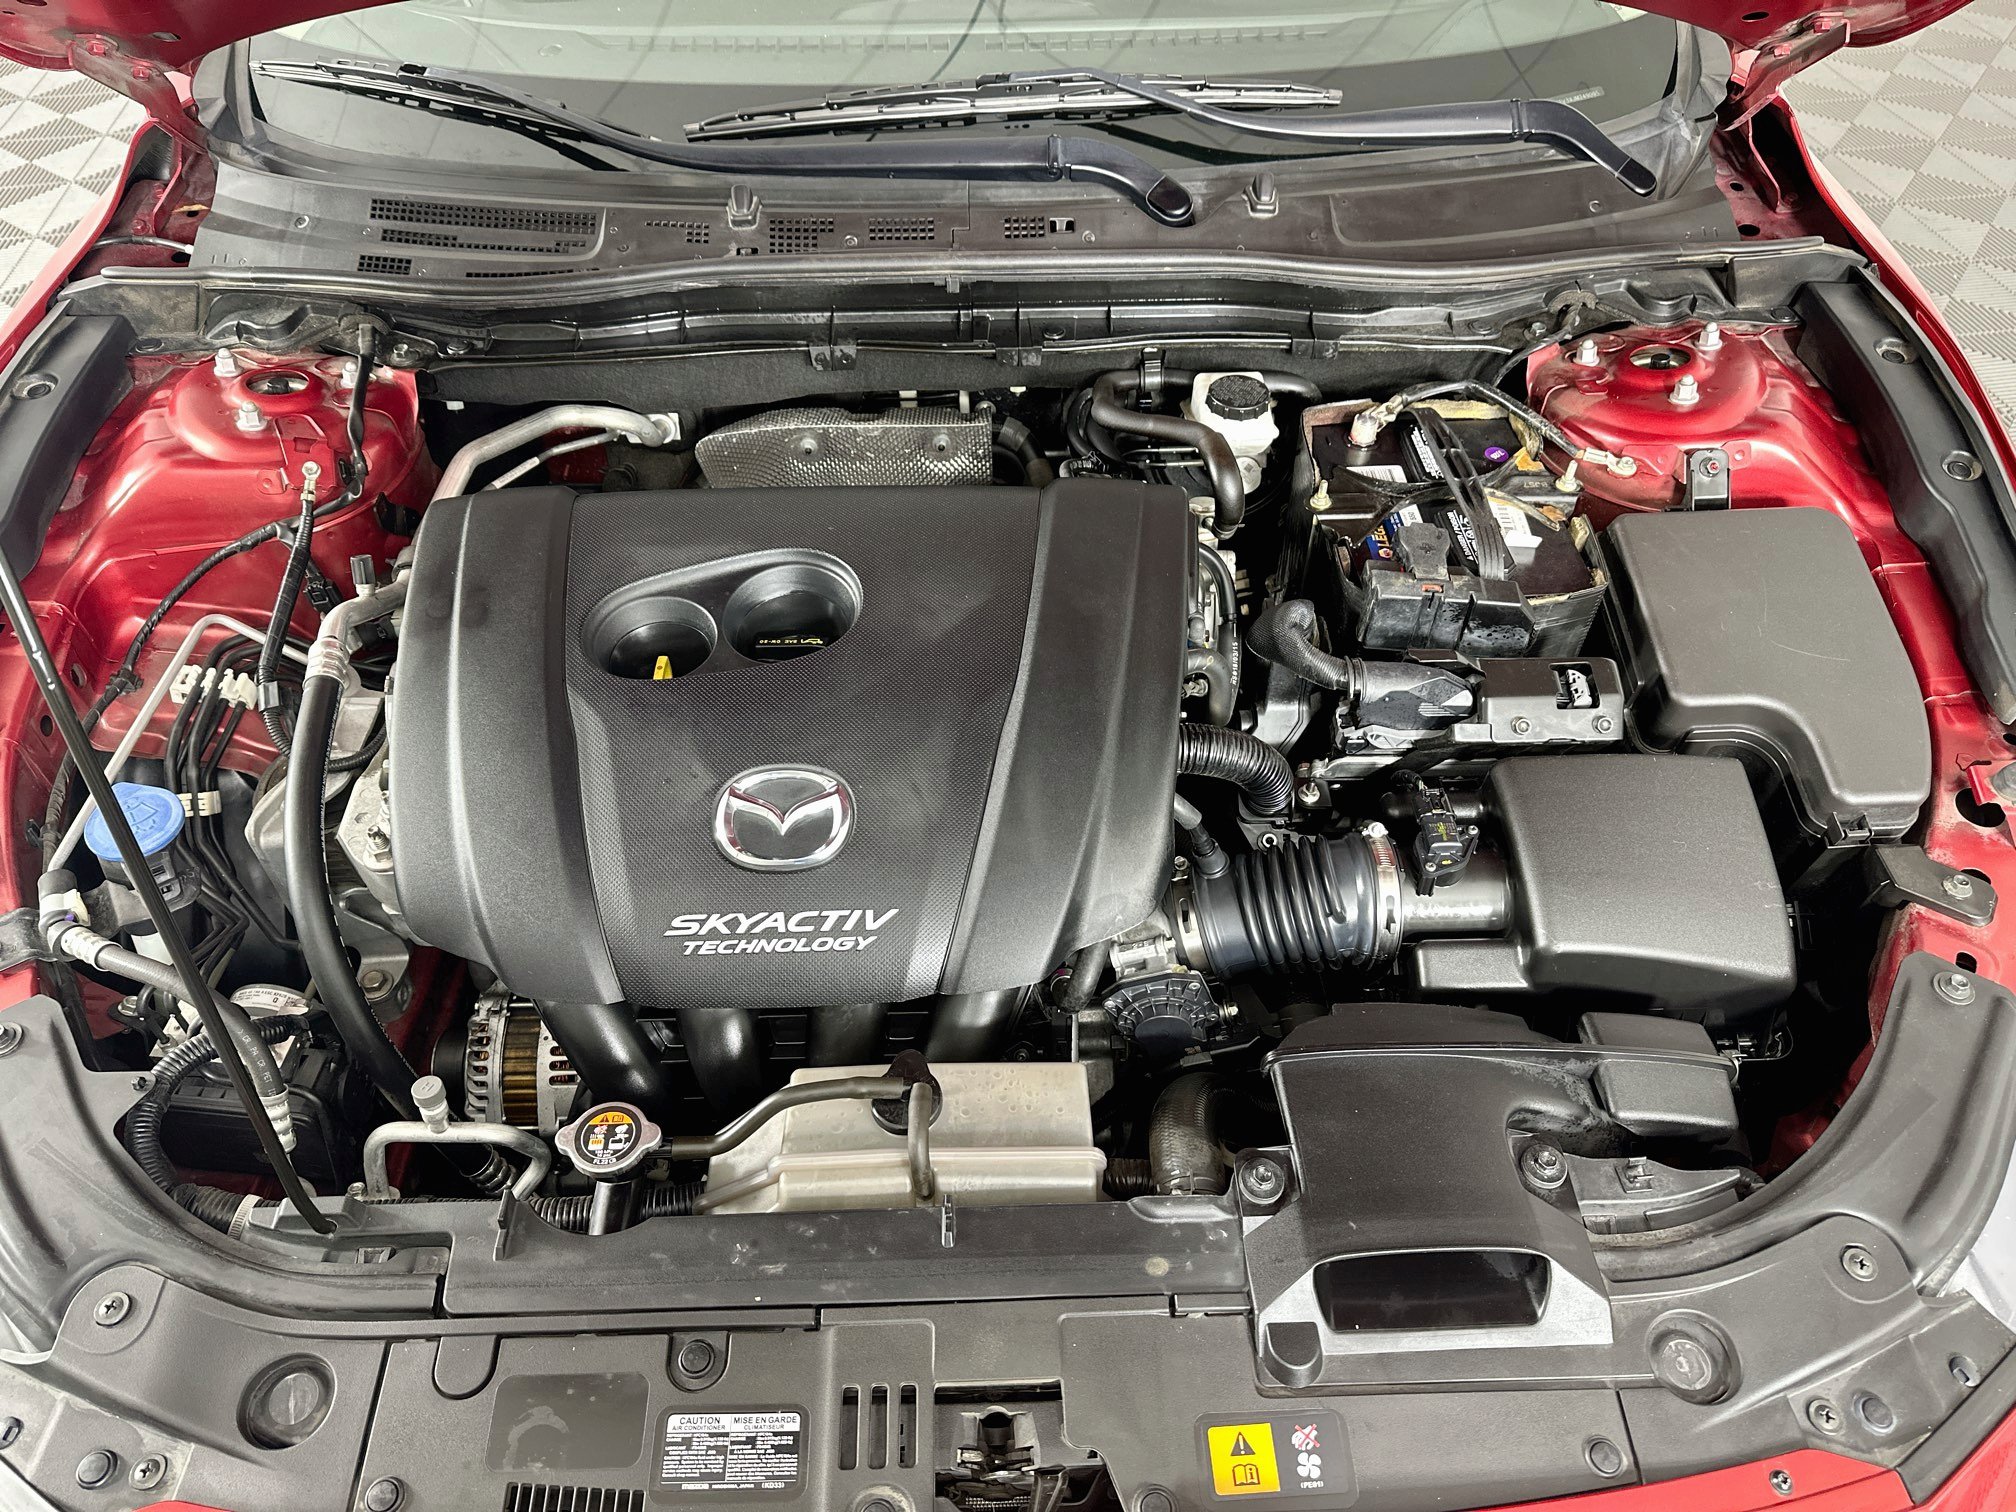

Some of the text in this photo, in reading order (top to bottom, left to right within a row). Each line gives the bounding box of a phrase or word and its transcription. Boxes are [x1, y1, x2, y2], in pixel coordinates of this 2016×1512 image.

[663, 908, 900, 937] SKYACTIV
[683, 936, 878, 956] TECHNOLOGY
[263, 1071, 273, 1083] PET
[679, 1417, 721, 1425] CAUTION
[755, 1416, 769, 1424] EN
[761, 1481, 785, 1489] (KD33)
